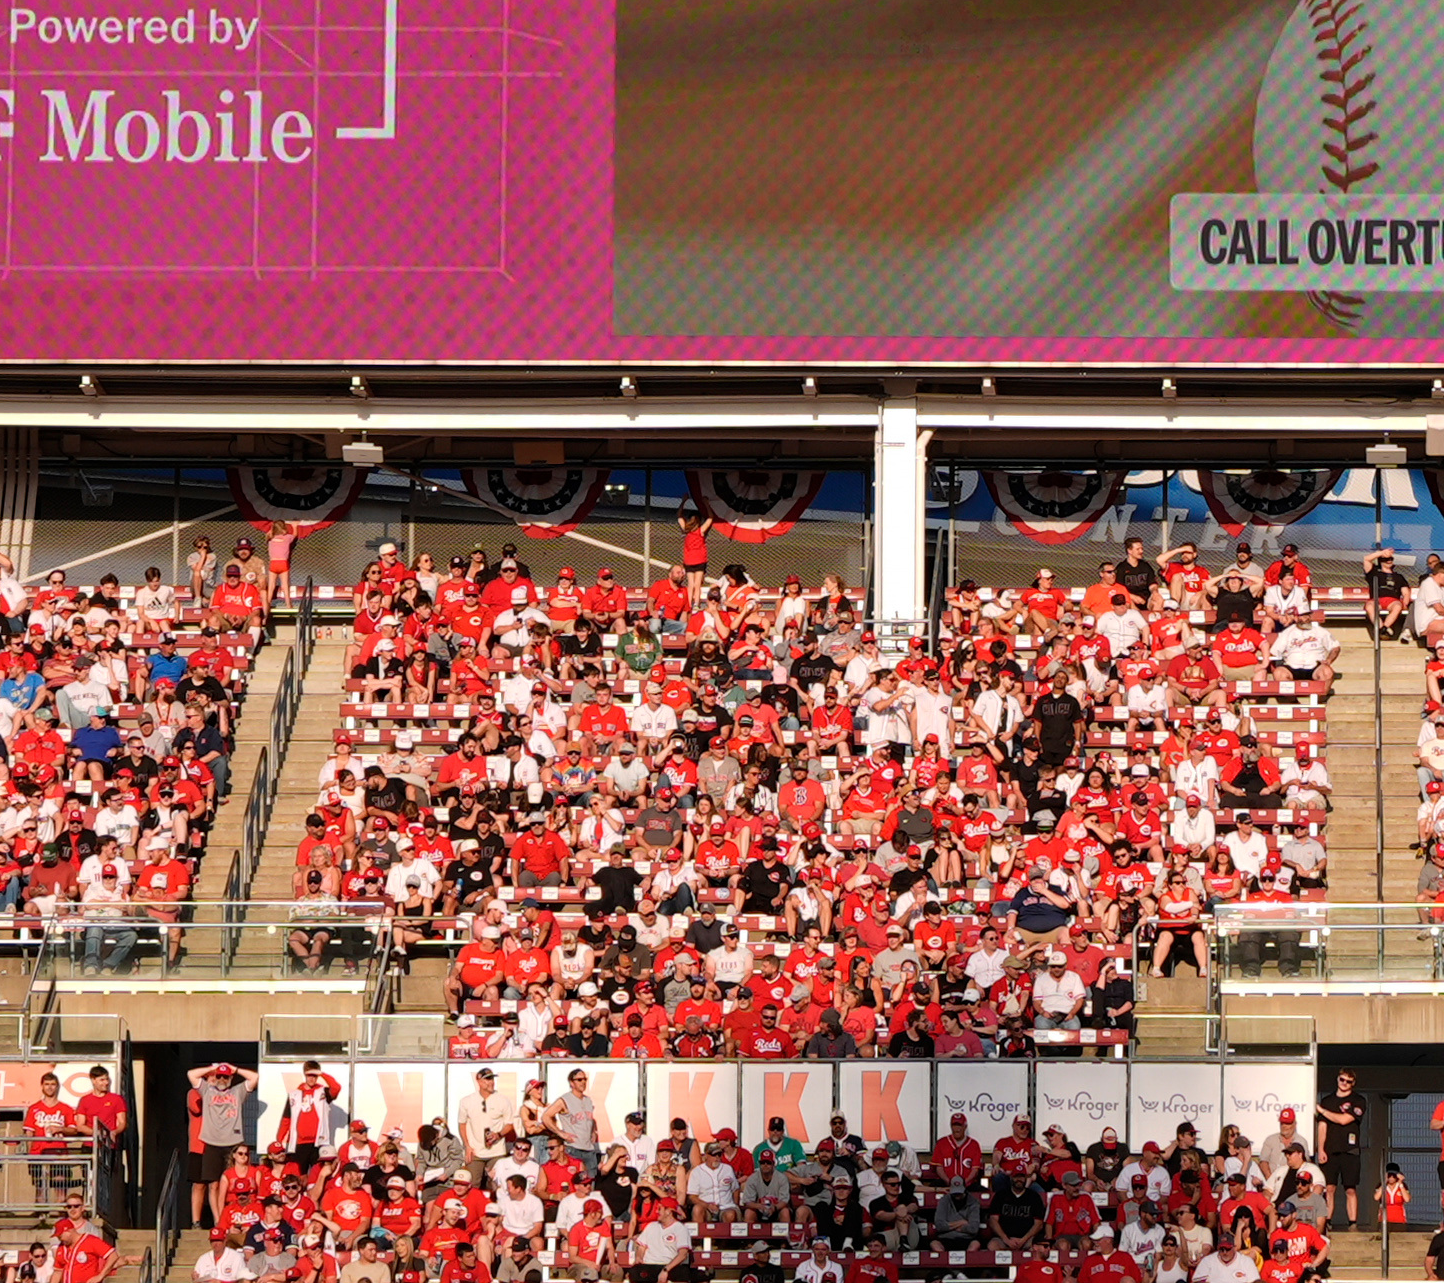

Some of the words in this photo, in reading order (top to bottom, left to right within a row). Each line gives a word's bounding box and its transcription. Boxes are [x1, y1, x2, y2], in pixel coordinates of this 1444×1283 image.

[9, 9, 196, 45] Powered
[209, 9, 259, 52] by
[39, 89, 312, 164] Mobile
[1200, 219, 1298, 266] CALL
[962, 822, 990, 836] Reds
[704, 857, 729, 869] Reds
[754, 1038, 782, 1051] Reds
[34, 1111, 65, 1127] Reds
[669, 1072, 715, 1143] K
[765, 1072, 810, 1143] K
[862, 1071, 907, 1142] K
[969, 1092, 1020, 1121] Kroger
[1068, 1091, 1119, 1120] Kroger
[1163, 1094, 1213, 1121] Kroger
[1003, 1148, 1030, 1162] Reds
[230, 1211, 258, 1224] Reds
